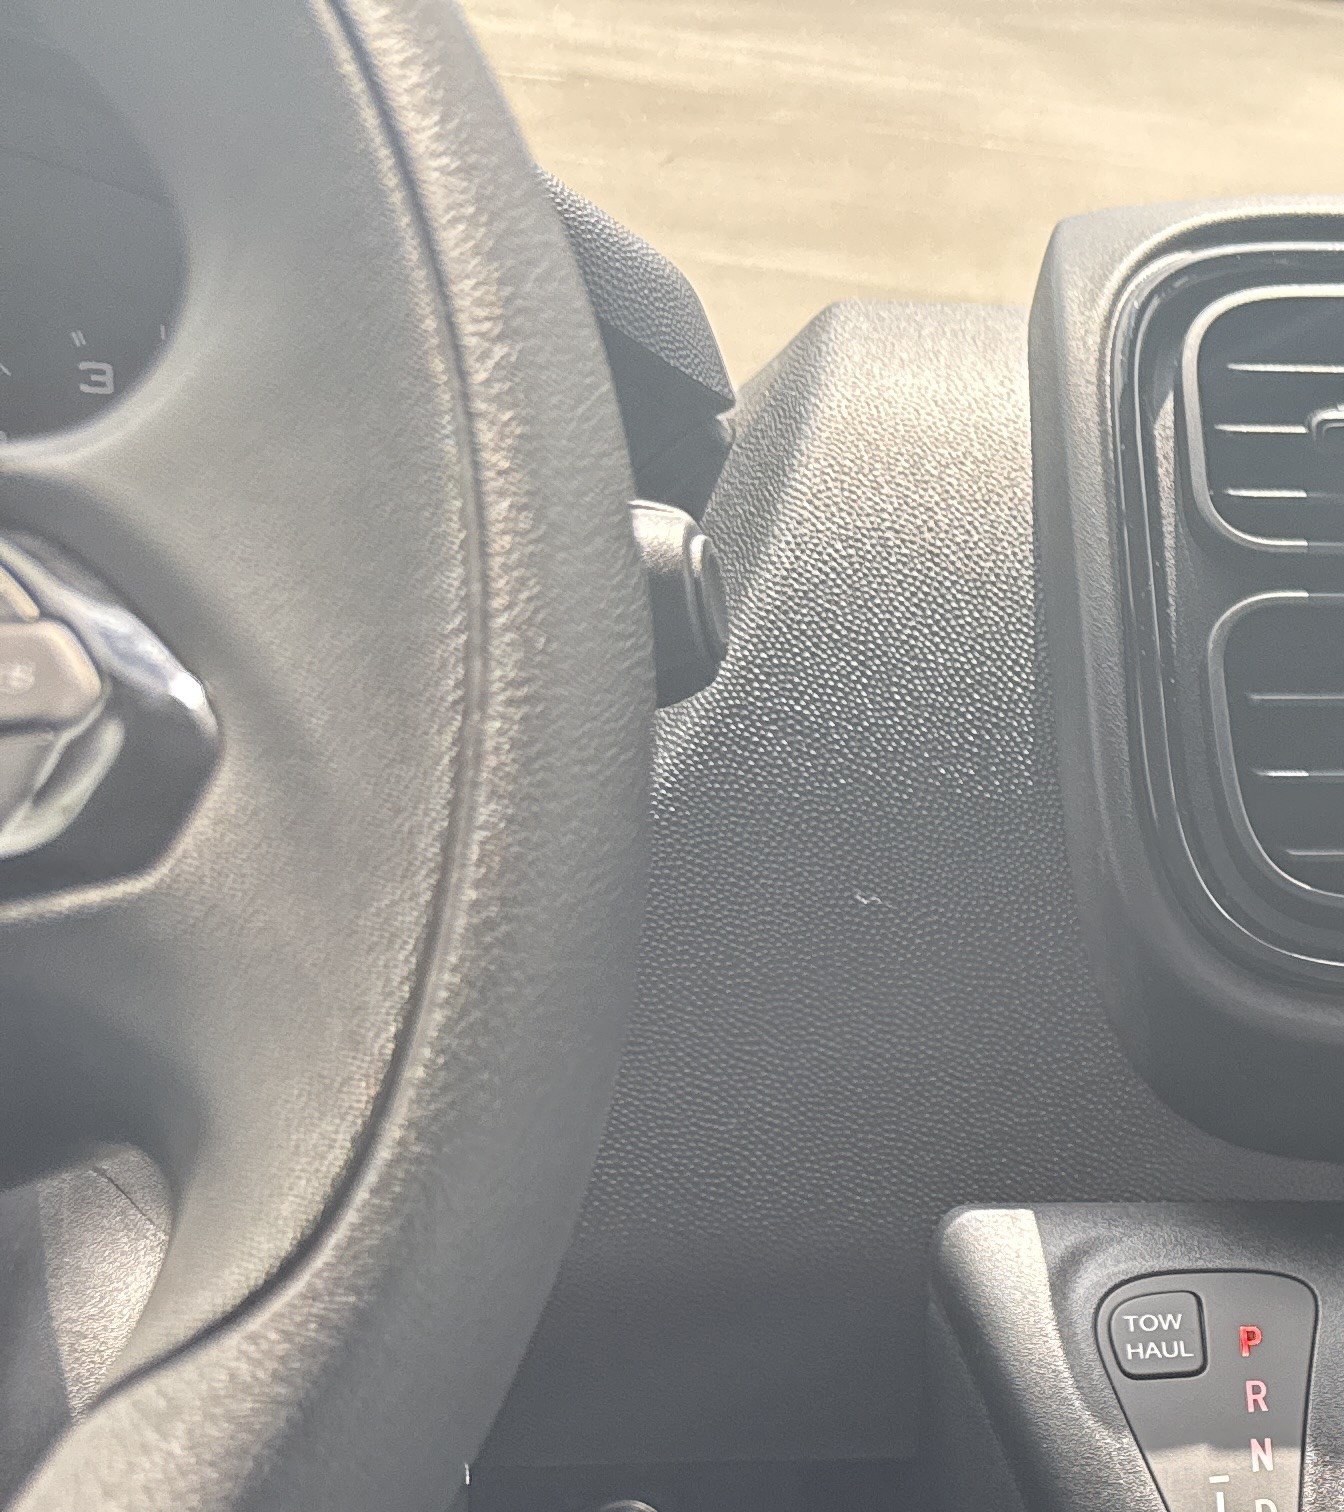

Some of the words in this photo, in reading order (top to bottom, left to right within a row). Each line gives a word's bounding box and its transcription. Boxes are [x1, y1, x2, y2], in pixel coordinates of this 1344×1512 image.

[1123, 1313, 1182, 1332] TOW
[1126, 1341, 1194, 1360] HAUL
[1239, 1325, 1262, 1357] P
[1245, 1380, 1269, 1412] R
[1250, 1438, 1274, 1472] N
